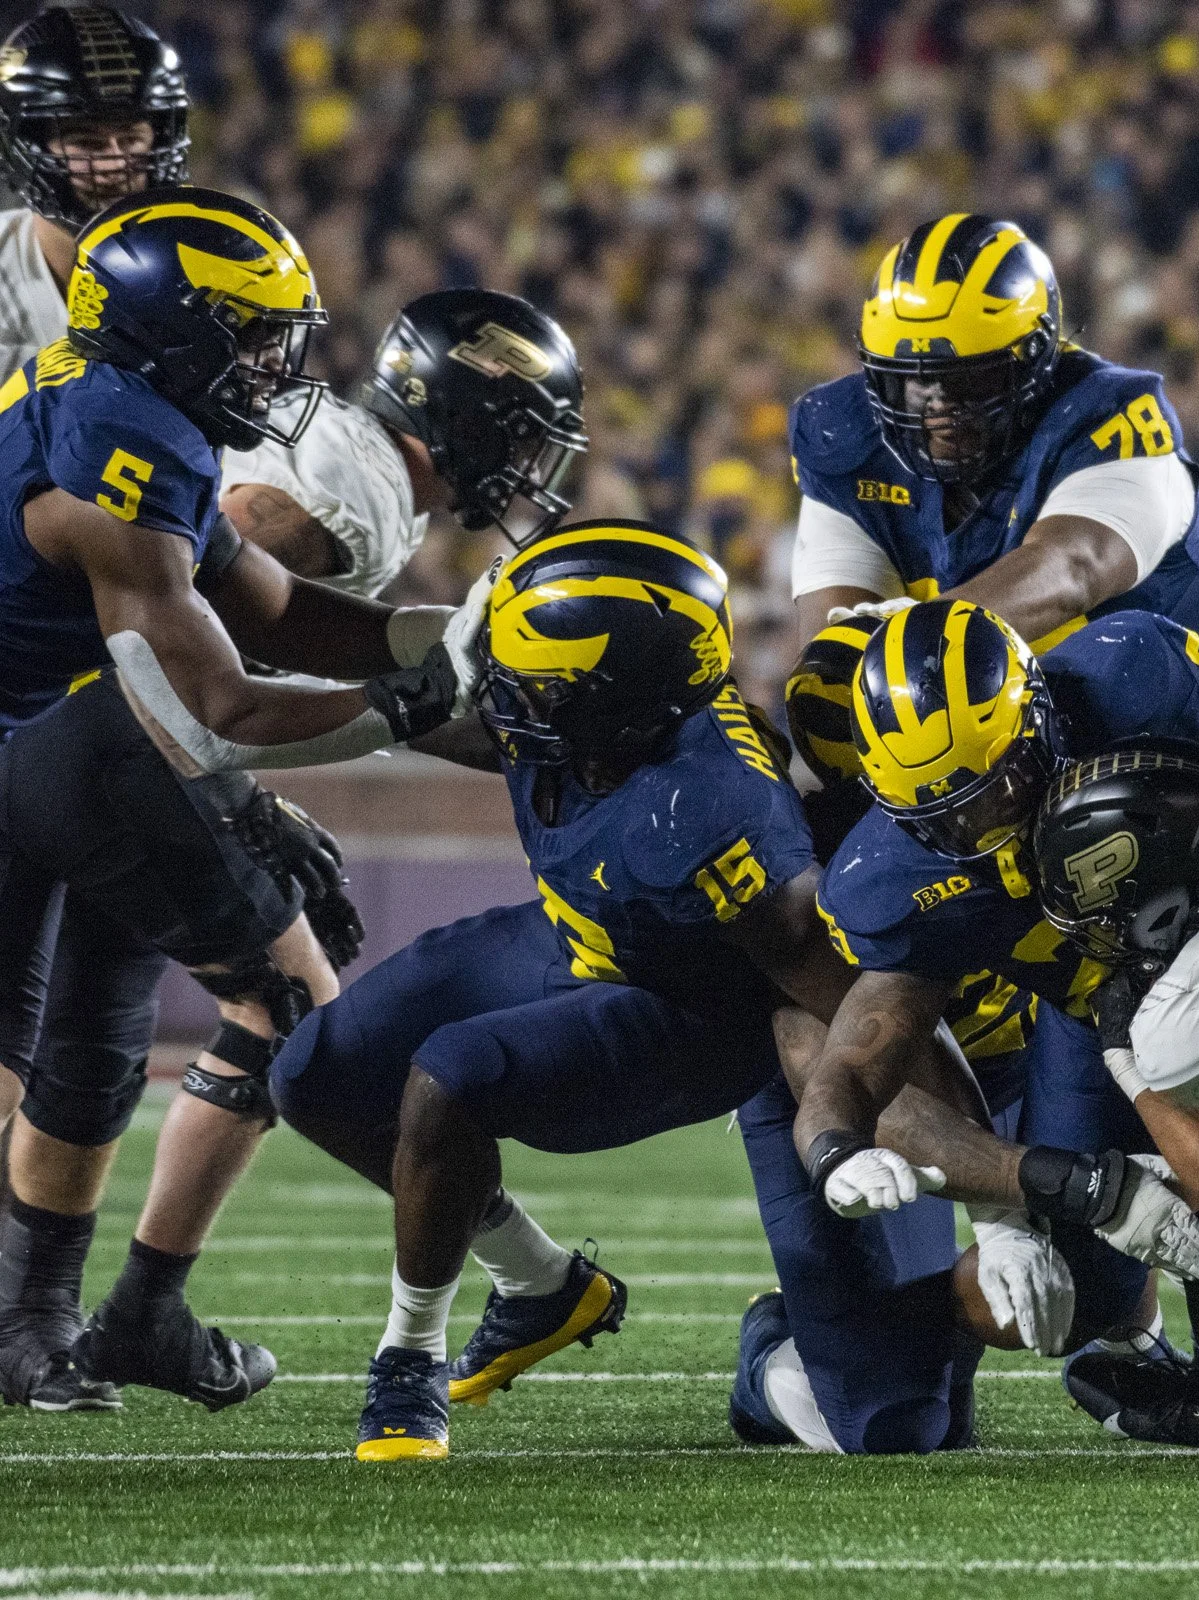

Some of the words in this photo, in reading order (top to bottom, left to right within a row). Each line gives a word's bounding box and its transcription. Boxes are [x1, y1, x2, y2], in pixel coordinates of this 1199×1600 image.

[447, 322, 553, 384] P
[1090, 393, 1175, 461] 78
[96, 448, 155, 522] 5
[694, 837, 767, 923] 15
[1064, 831, 1140, 913] P
